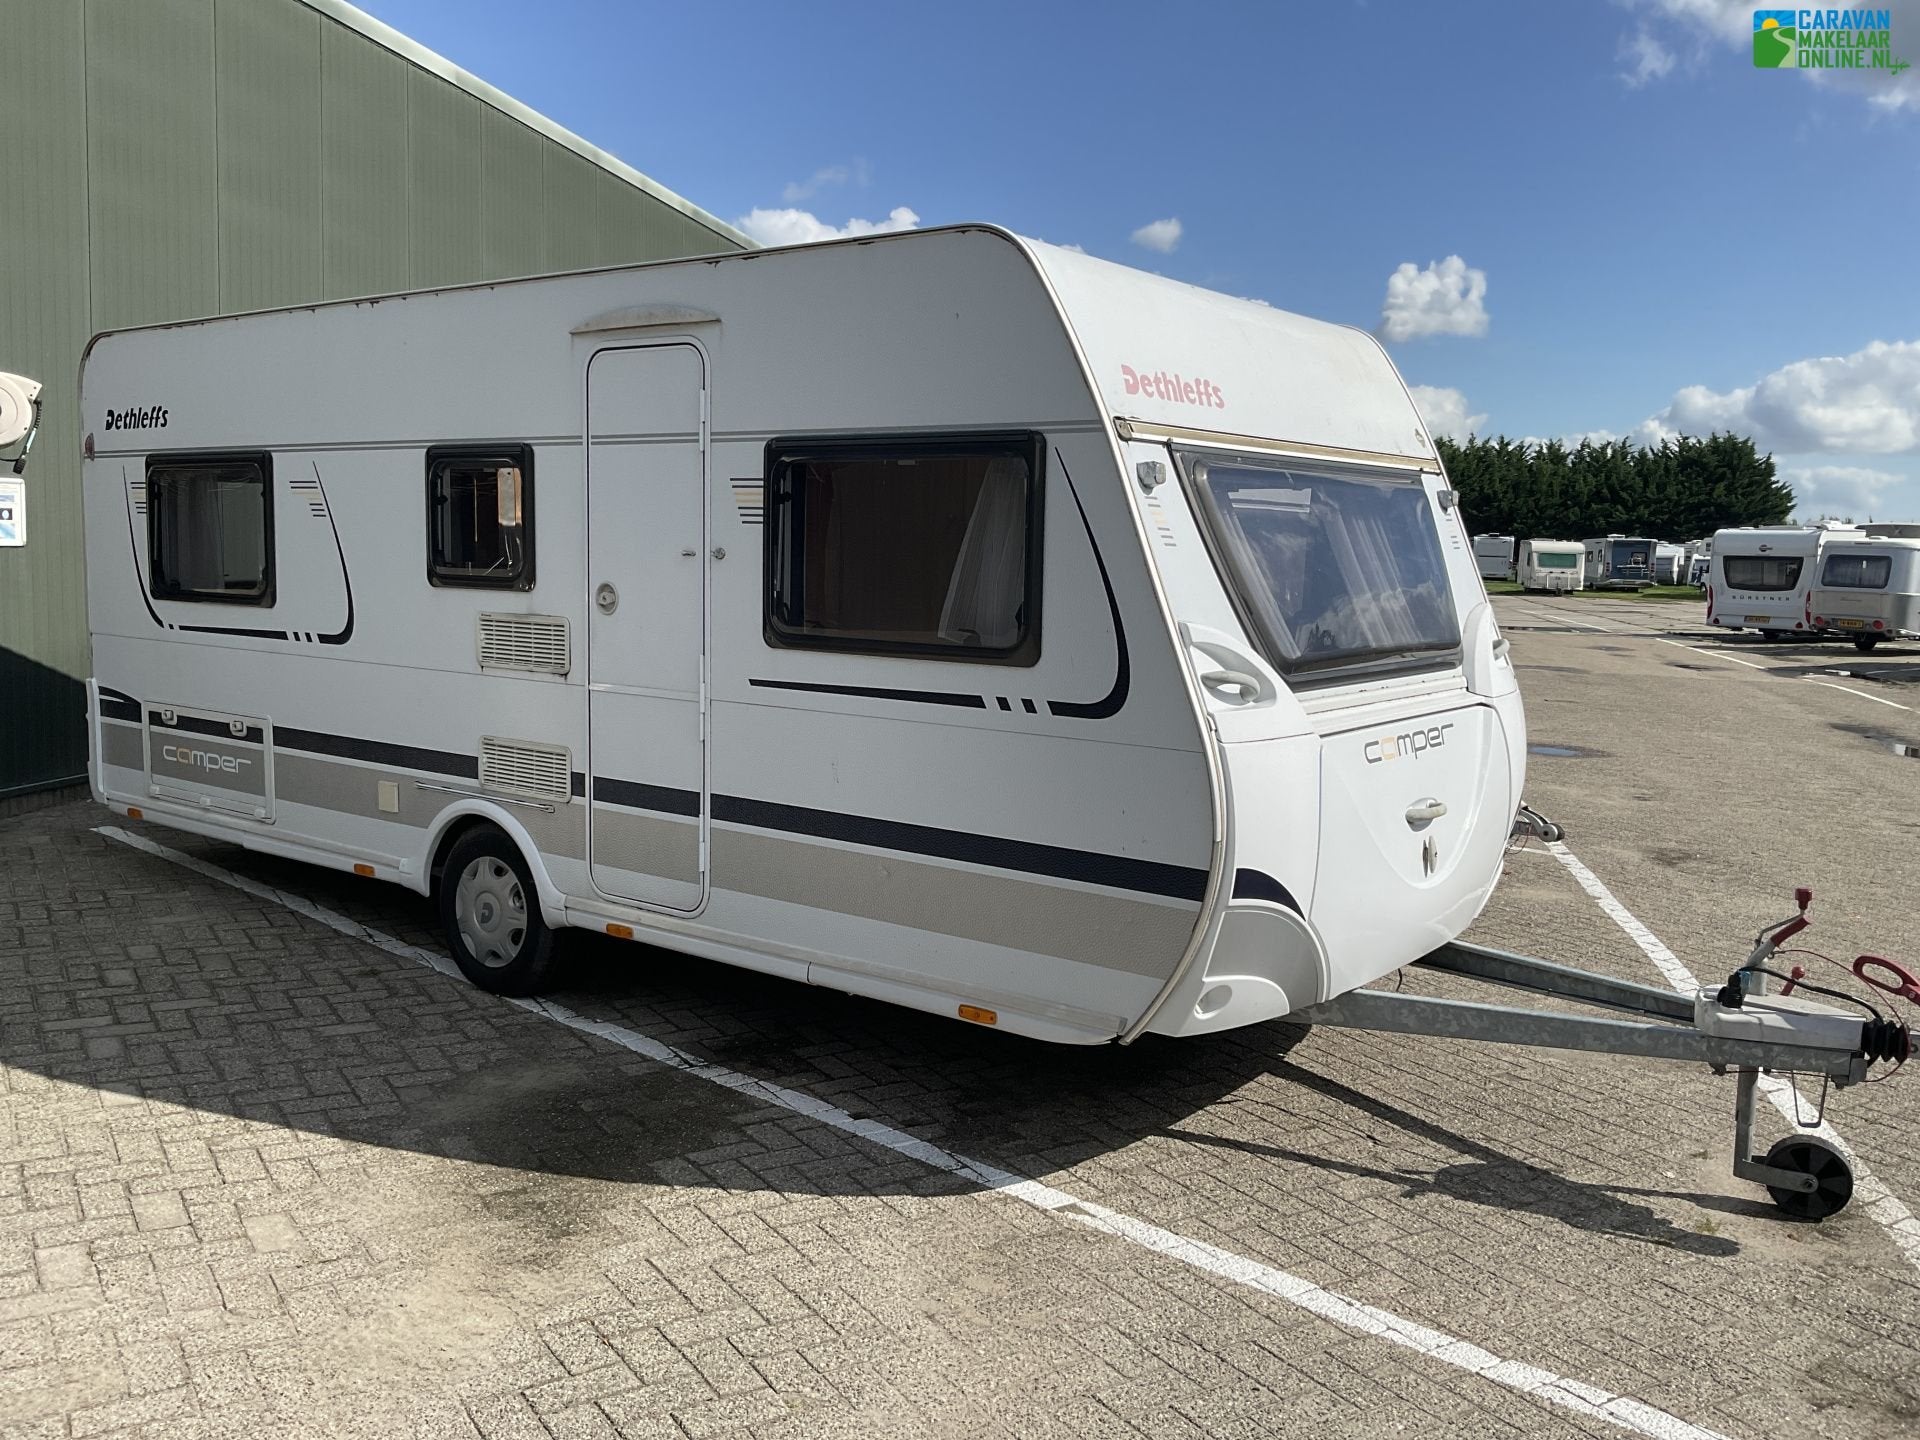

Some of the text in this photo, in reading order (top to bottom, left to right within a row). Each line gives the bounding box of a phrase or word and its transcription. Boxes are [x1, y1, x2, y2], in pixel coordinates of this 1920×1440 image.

[1121, 364, 1225, 409] Dethleffs
[105, 406, 169, 430] Dethleffs
[163, 745, 252, 773] camper
[1364, 723, 1454, 764] camper
